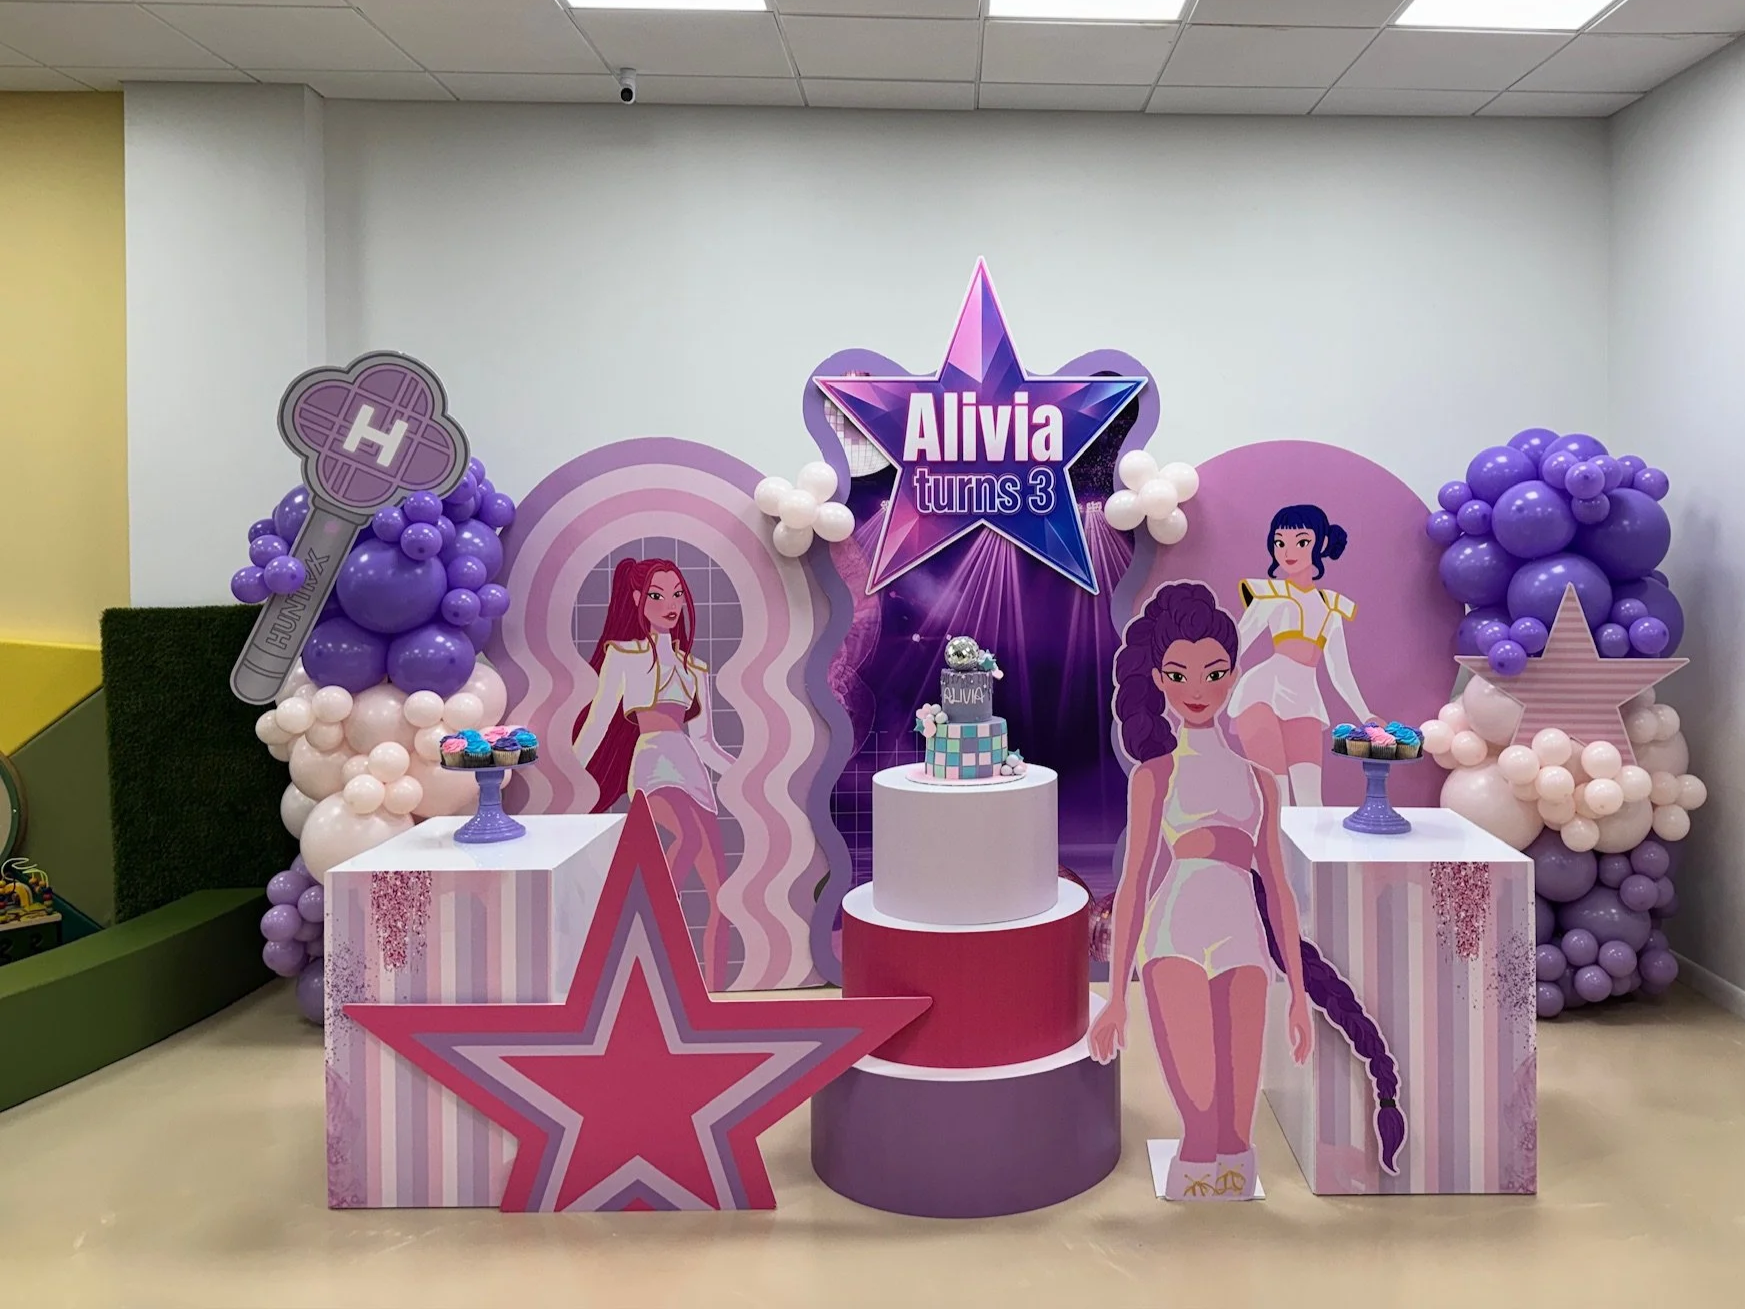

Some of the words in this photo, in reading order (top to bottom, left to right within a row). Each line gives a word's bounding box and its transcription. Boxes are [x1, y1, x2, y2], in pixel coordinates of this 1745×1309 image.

[343, 404, 408, 467] H
[903, 391, 1063, 462] Alivia
[914, 467, 1021, 513] turns
[1028, 467, 1055, 513] 3
[944, 687, 985, 704] ALIVIA
